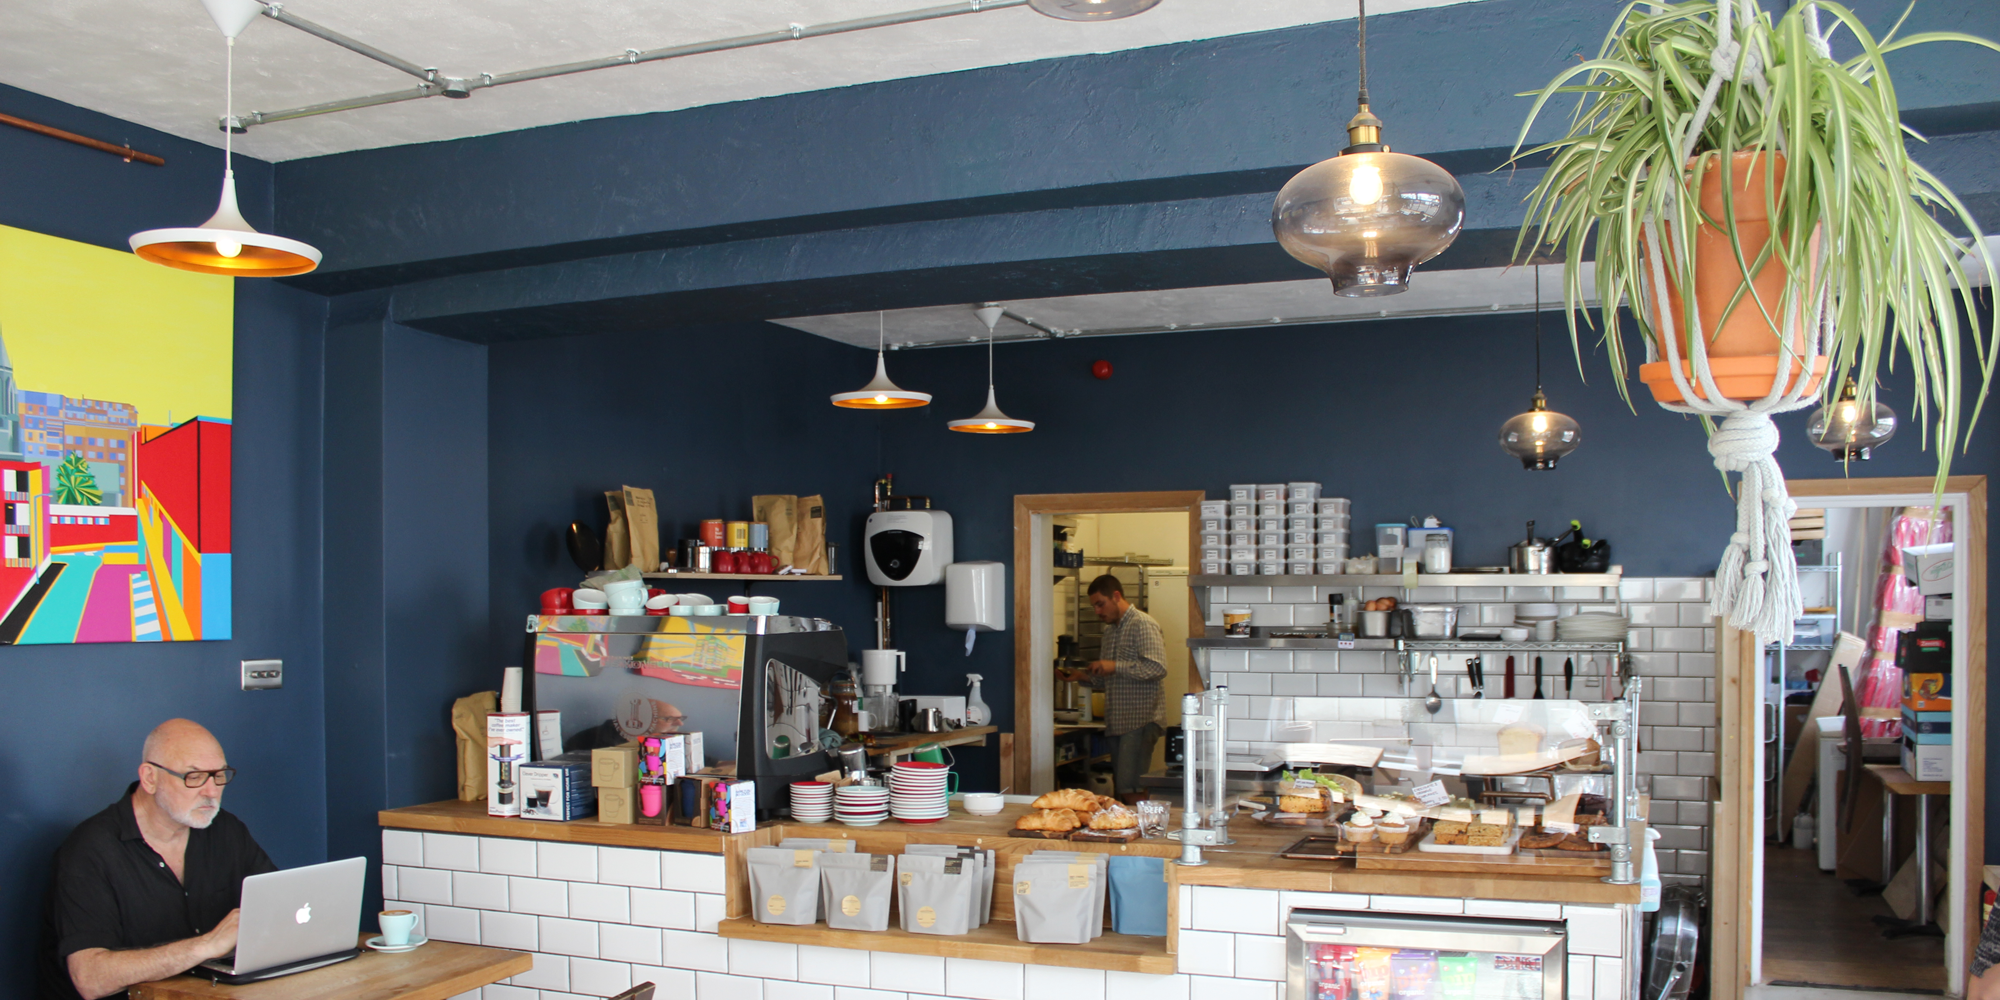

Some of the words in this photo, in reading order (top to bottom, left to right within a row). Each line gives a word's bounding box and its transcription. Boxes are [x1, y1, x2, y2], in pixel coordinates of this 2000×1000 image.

[1318, 981, 1340, 990] organic
[1360, 980, 1386, 988] organic
[1398, 990, 1426, 998] organic
[1444, 989, 1472, 998] organic
